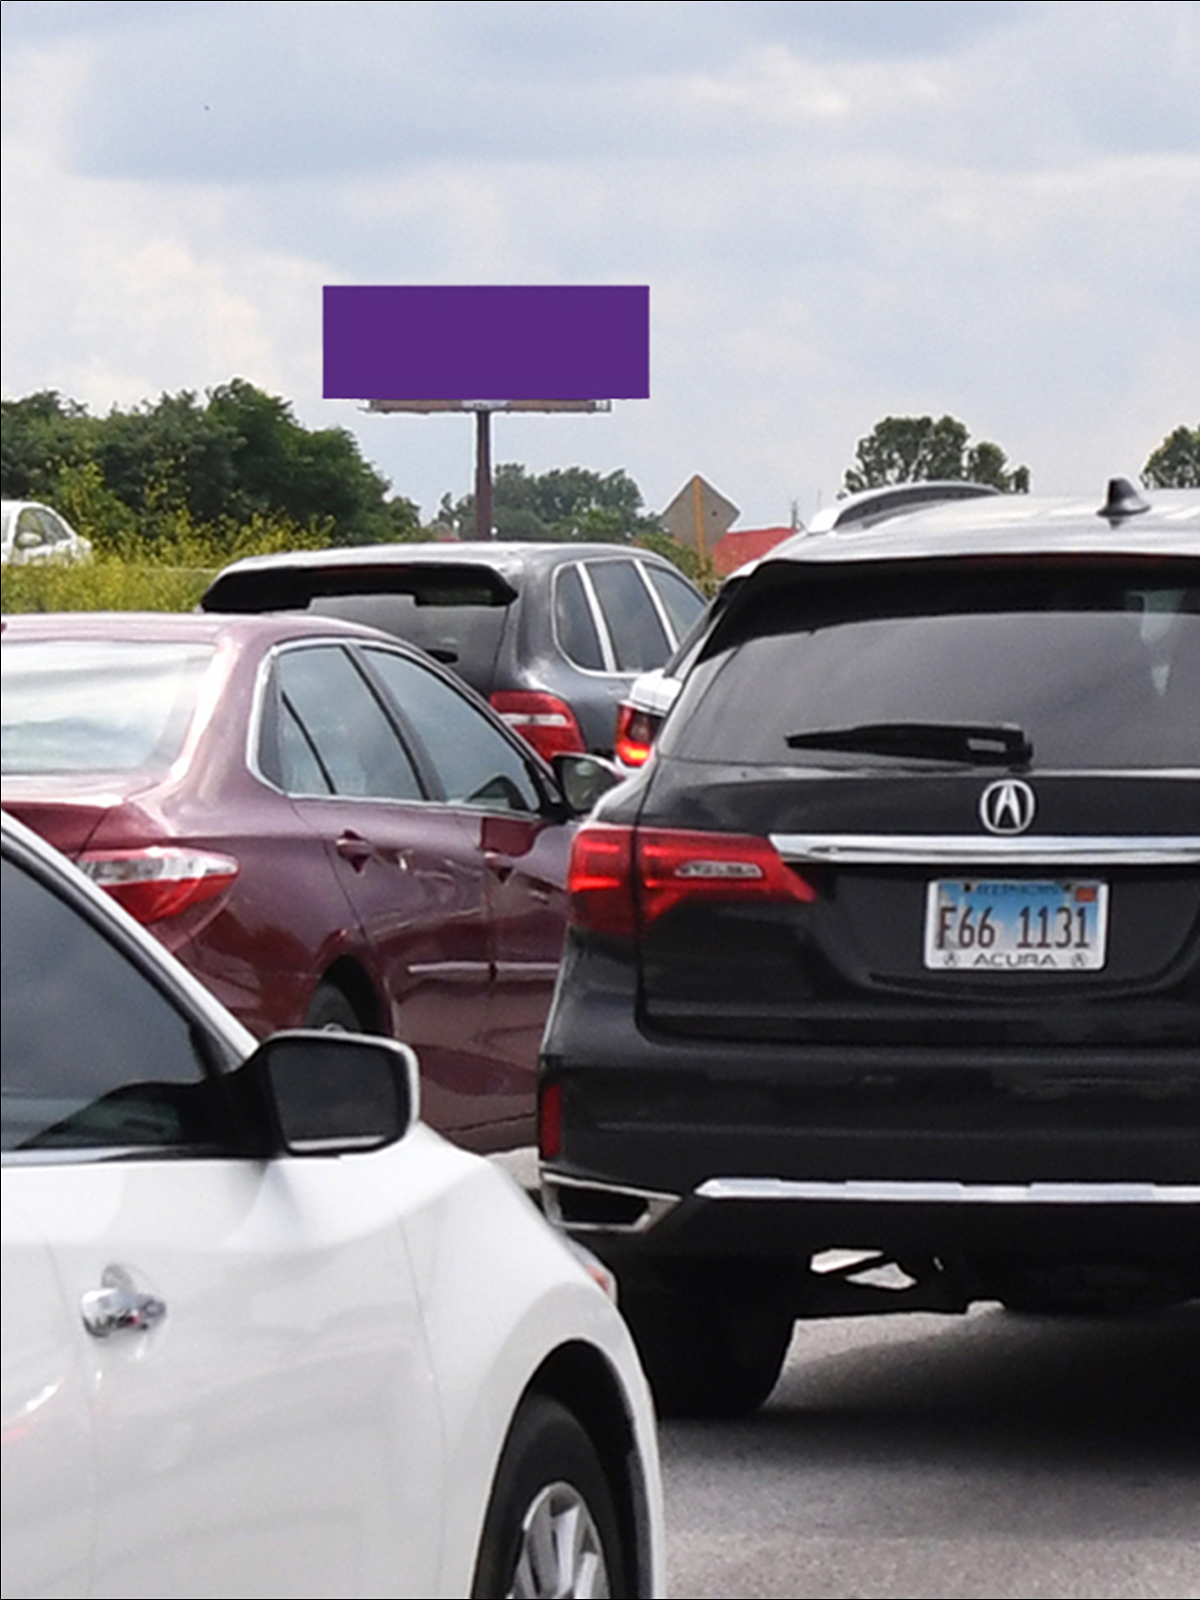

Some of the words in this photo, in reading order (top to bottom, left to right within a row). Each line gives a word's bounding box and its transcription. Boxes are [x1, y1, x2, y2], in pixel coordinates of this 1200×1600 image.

[936, 906, 996, 950] F66
[1017, 906, 1090, 949] 1131
[973, 953, 1058, 967] ACURA
